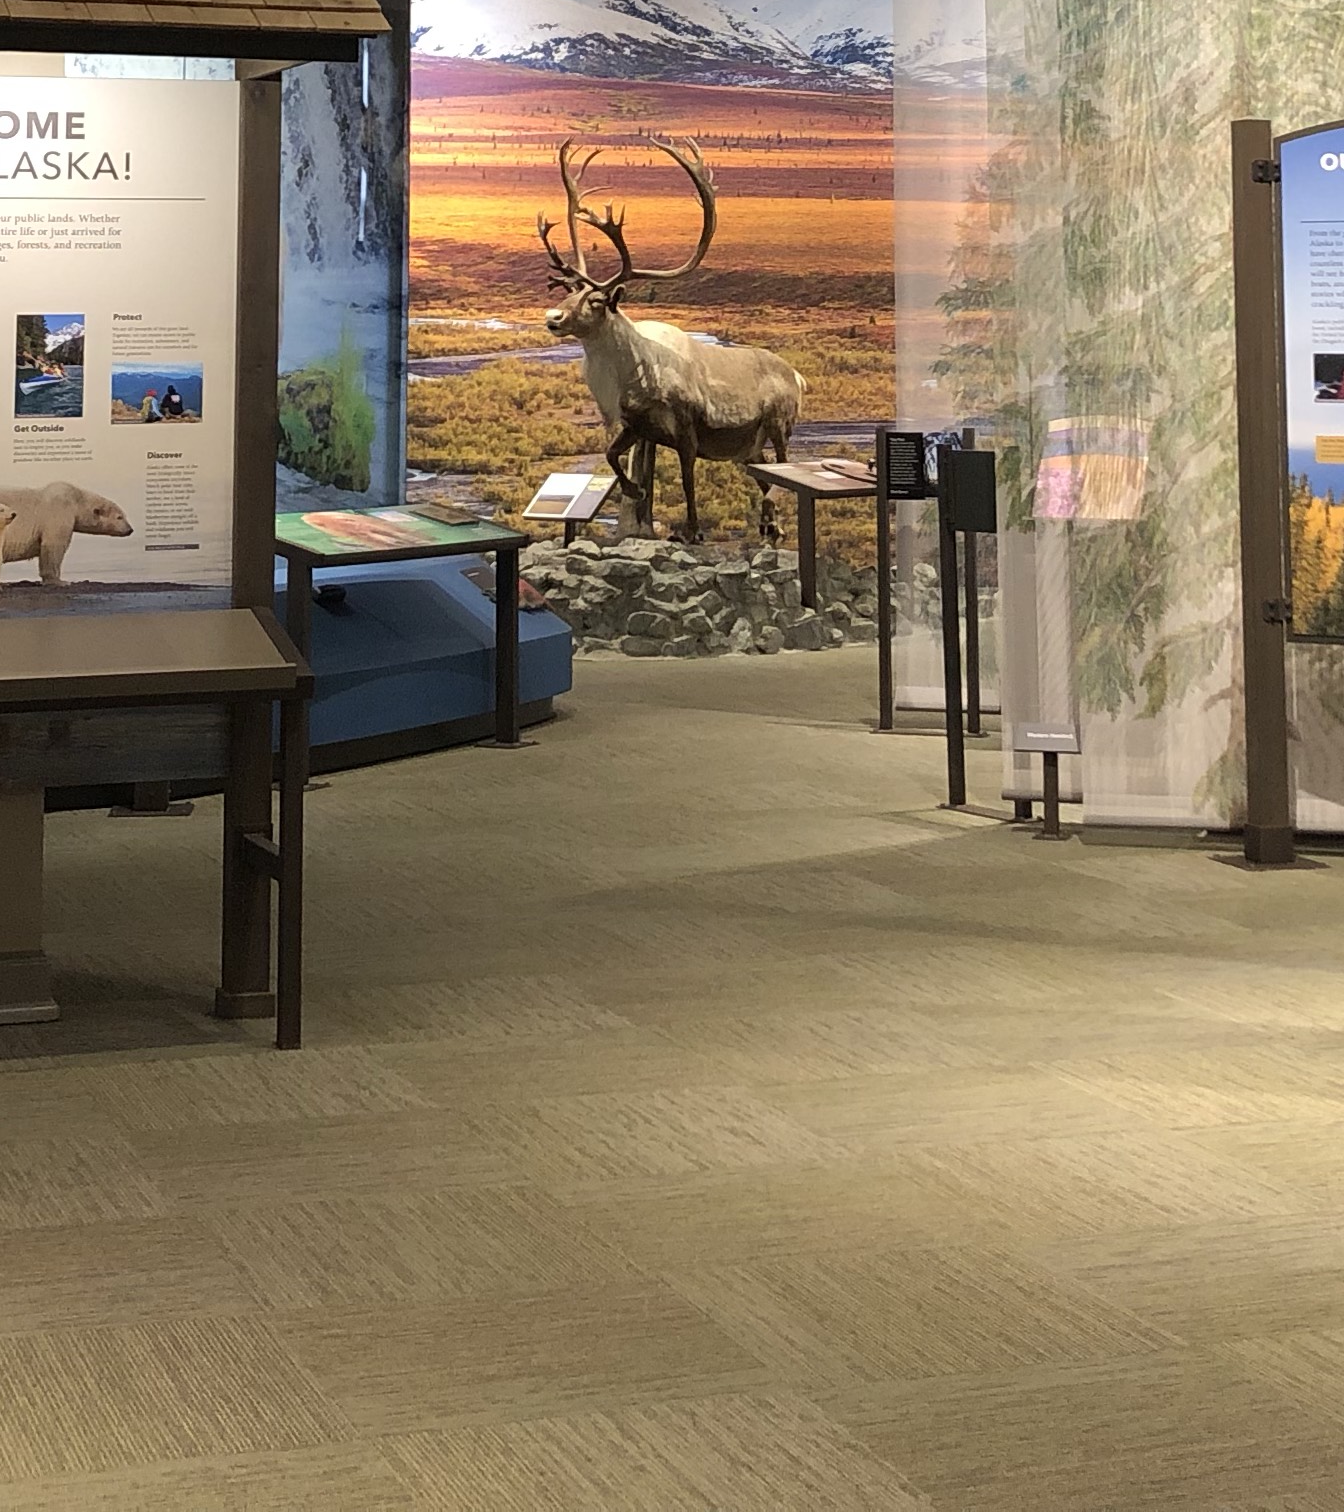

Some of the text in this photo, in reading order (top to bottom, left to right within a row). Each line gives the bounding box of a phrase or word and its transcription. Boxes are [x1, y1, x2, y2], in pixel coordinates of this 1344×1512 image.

[15, 214, 45, 225] public
[48, 214, 75, 222] lands.
[78, 214, 120, 223] Whether
[20, 227, 35, 235] life
[49, 227, 68, 239] just
[71, 227, 105, 236] arrived
[108, 227, 122, 236] for
[17, 240, 51, 249] forests,
[54, 240, 72, 249] and
[75, 241, 121, 249] recreation
